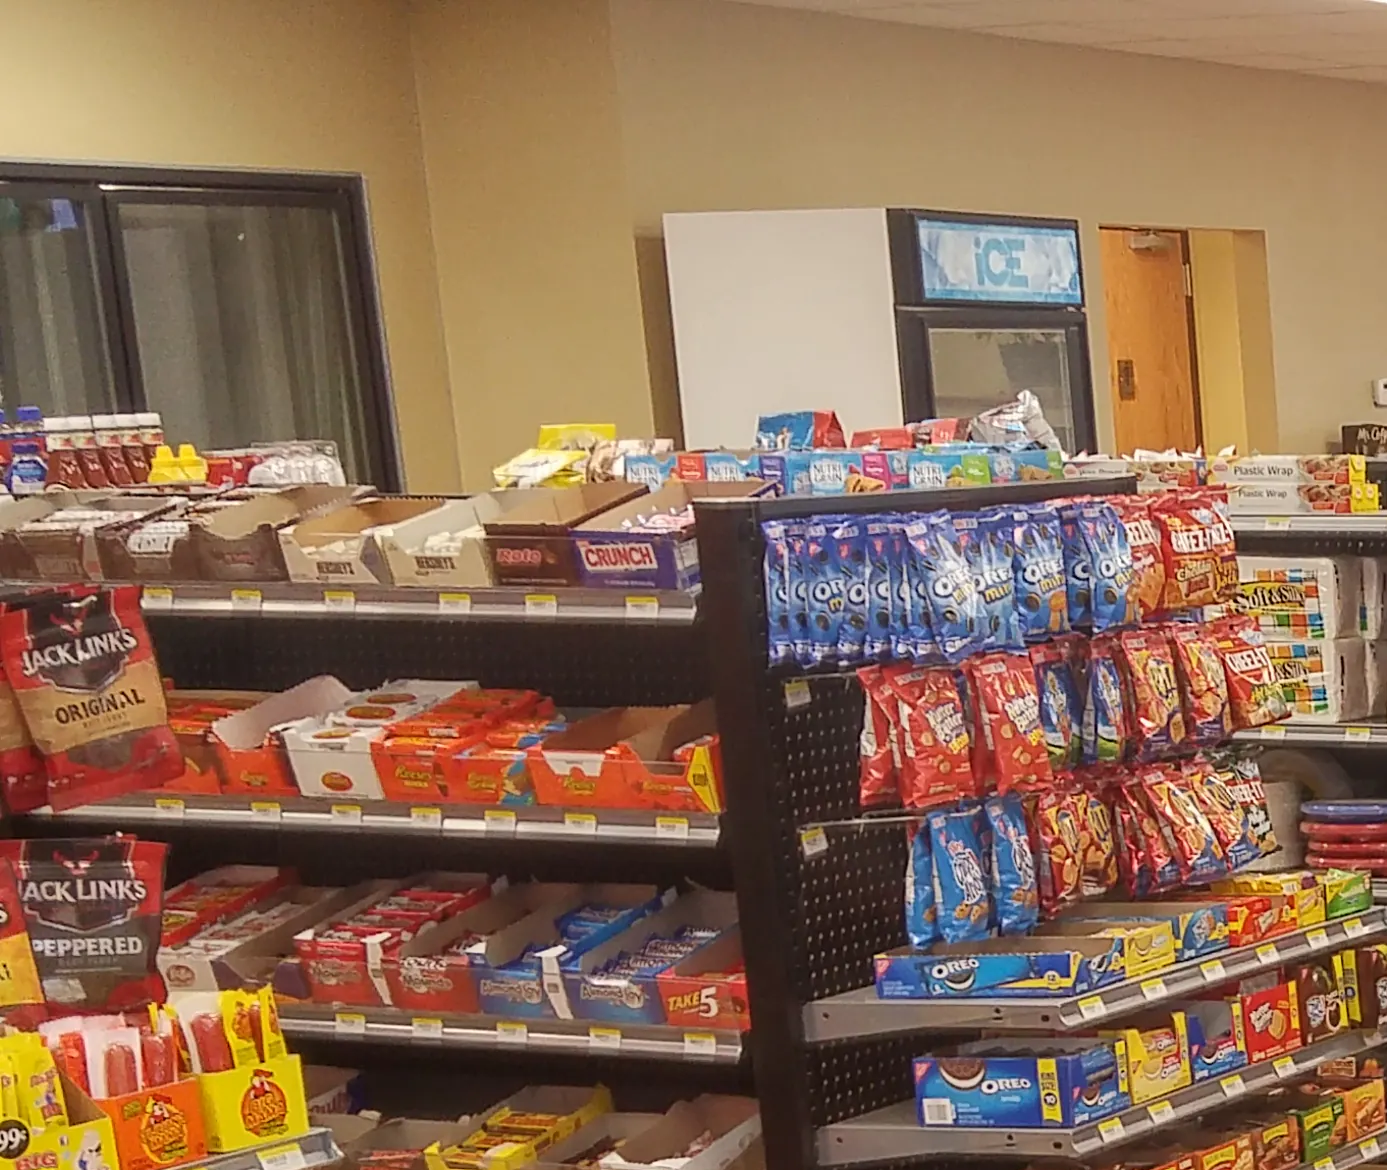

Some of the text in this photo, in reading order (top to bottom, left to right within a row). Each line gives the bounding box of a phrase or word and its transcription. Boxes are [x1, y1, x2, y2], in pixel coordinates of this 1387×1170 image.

[1233, 464, 1293, 478] Plastic Wrap
[584, 543, 654, 569] CRUNCH
[1234, 586, 1270, 612] Soft
[21, 641, 80, 676] JACK
[55, 688, 146, 725] ORIGINAL
[19, 880, 77, 902] ACK
[32, 936, 143, 958] PEPPERED
[931, 958, 980, 980] OREO
[668, 986, 719, 1018] TAKE 5
[980, 1077, 1031, 1094] OREO
